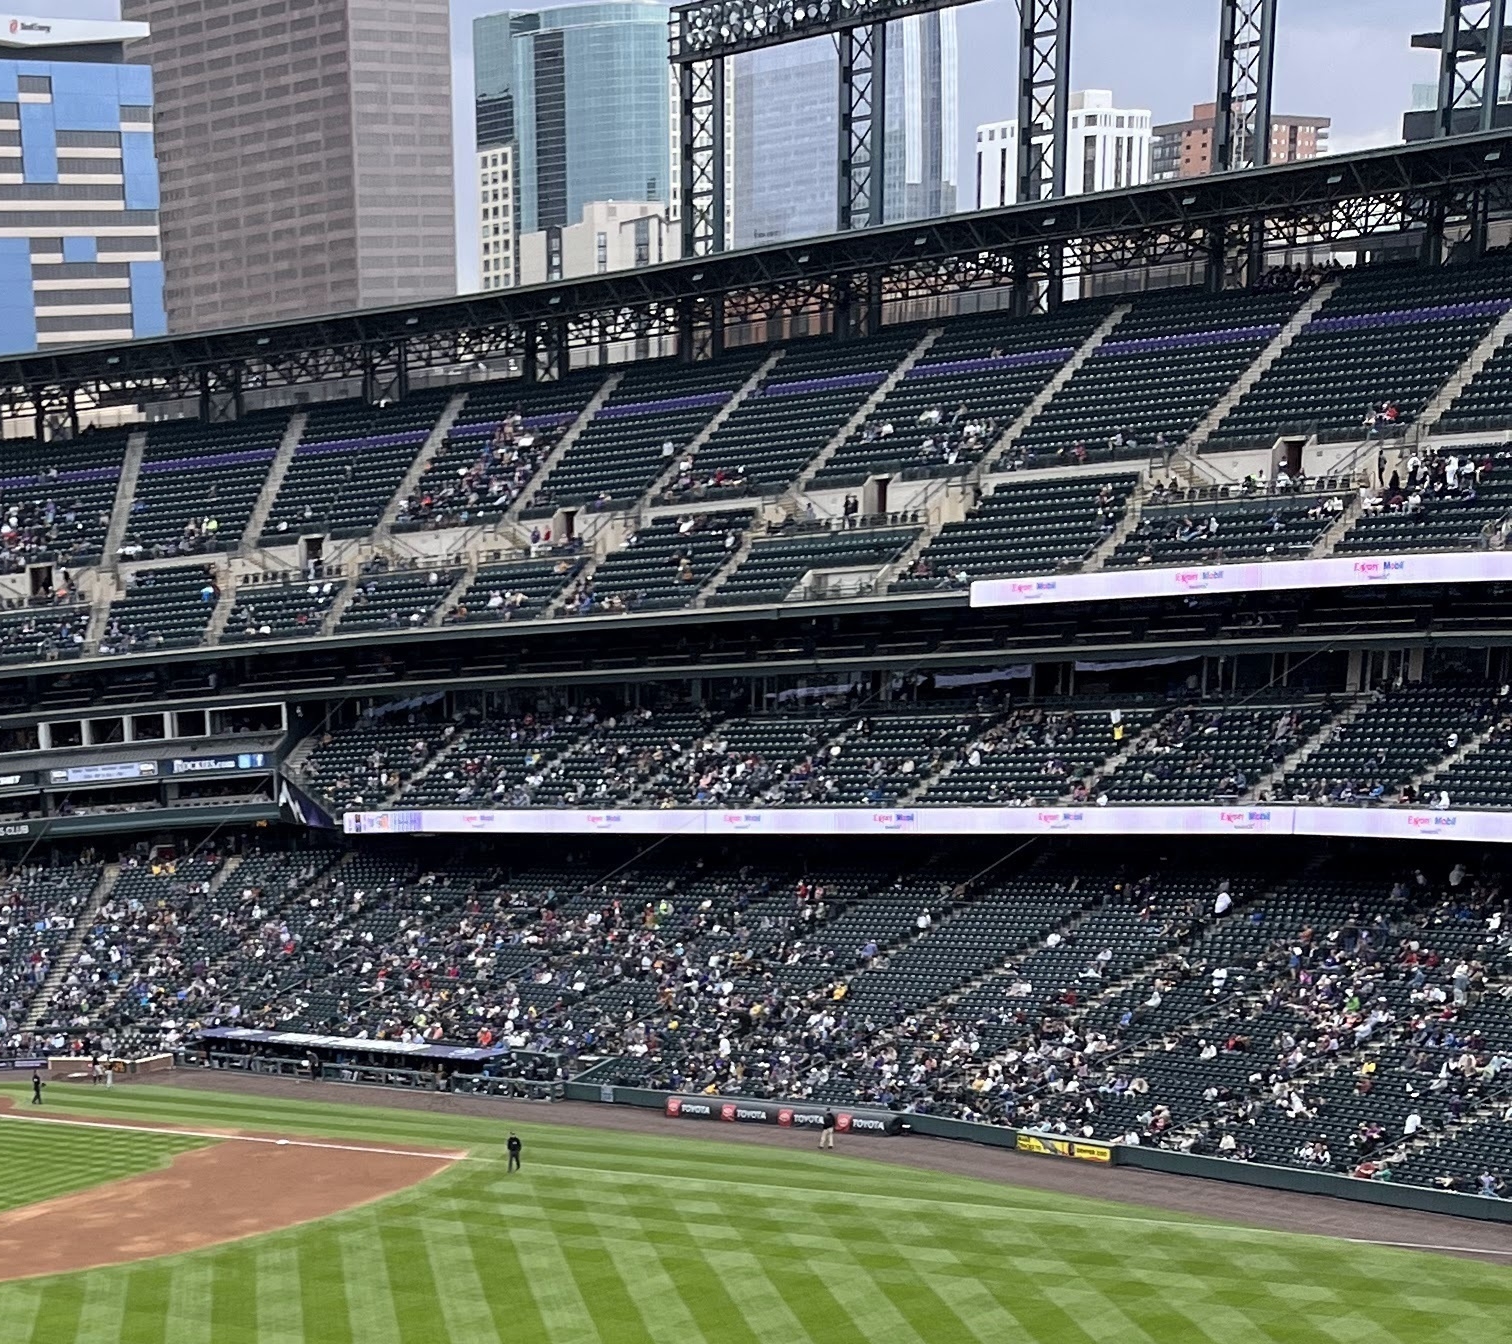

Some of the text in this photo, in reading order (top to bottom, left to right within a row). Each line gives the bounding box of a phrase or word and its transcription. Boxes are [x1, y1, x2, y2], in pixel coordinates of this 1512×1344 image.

[6, 825, 30, 836] CLUB
[681, 1104, 711, 1115] TOYOTA
[737, 1109, 767, 1120] TOYOTA
[793, 1113, 824, 1125] TOYOTA
[852, 1118, 885, 1131] TOYOTA
